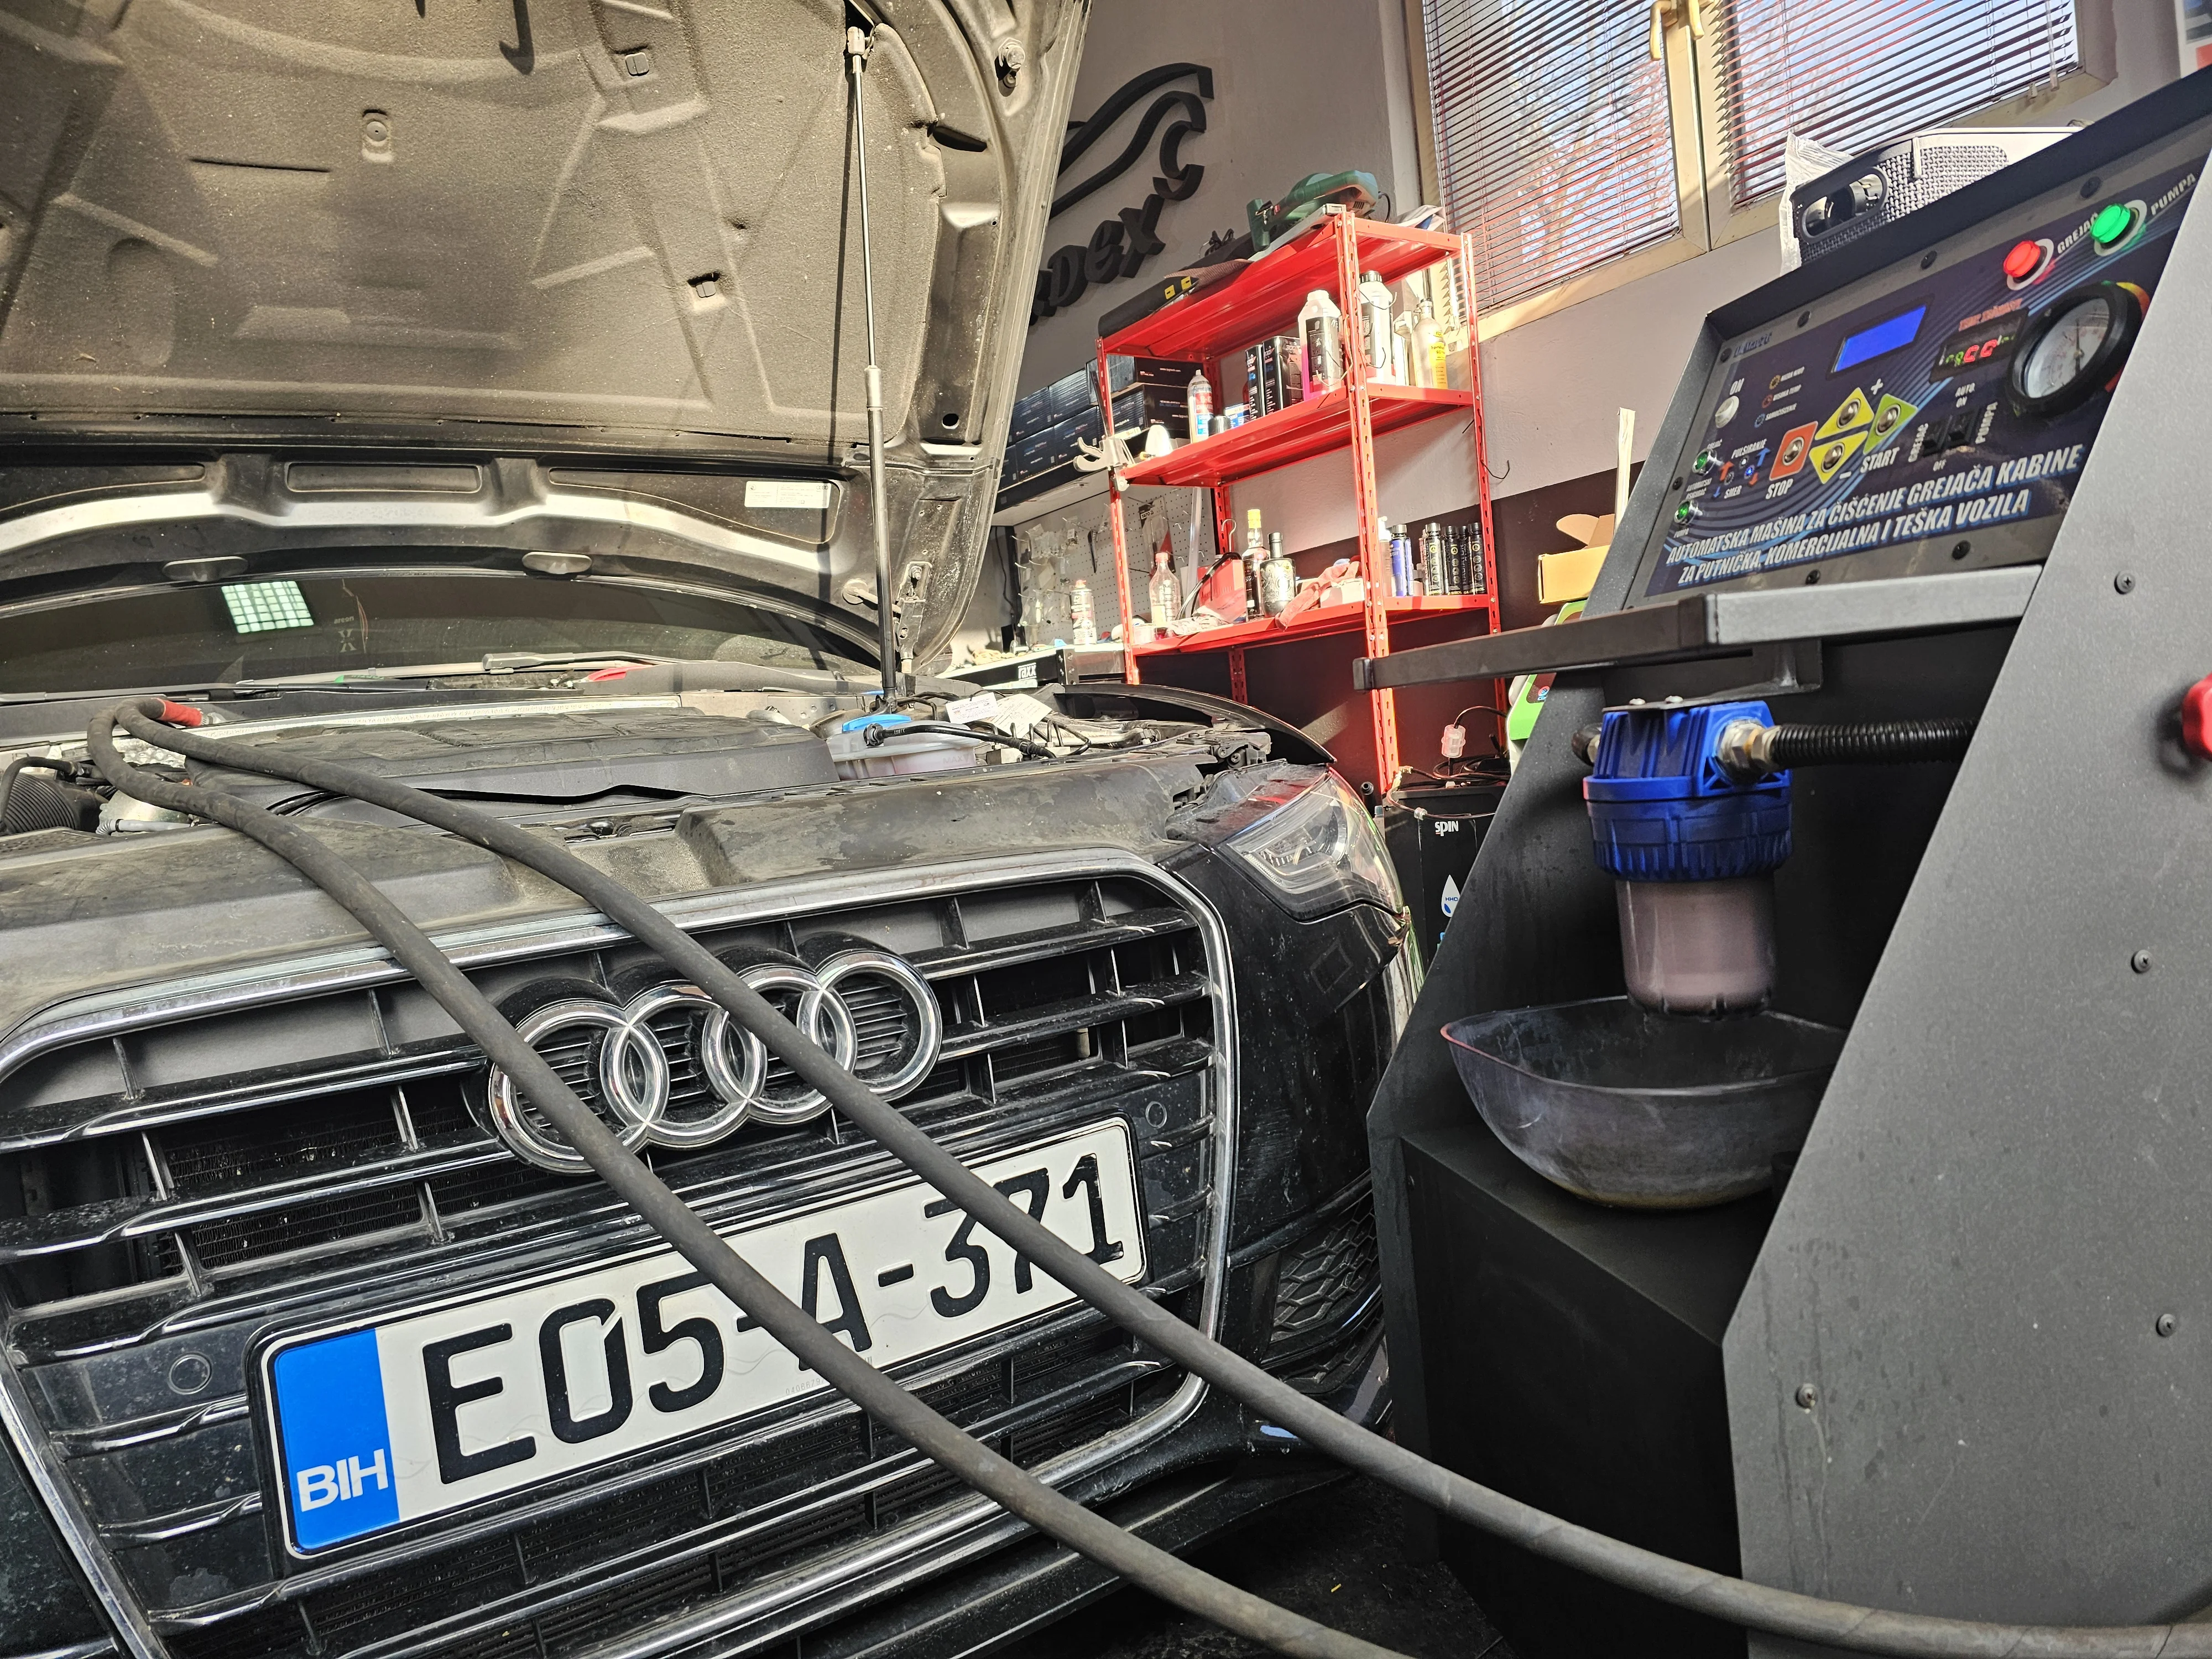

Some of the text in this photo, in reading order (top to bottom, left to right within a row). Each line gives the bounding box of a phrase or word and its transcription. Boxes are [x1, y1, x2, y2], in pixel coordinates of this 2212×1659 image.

[2151, 173, 2196, 215] PUMPA
[1729, 378, 1745, 395] ON
[1975, 401, 1998, 444] PUMPA
[1859, 446, 1900, 474] START
[1933, 458, 1947, 472] OFF
[1724, 485, 1743, 499] SMER
[1765, 478, 1794, 499] STOP
[1666, 444, 2084, 565] AUTOMATSKA MAŠINA ZA ČIŠĆENJE GREJAČA KABINE
[1678, 565, 1695, 585] ZA
[1764, 521, 1881, 566] KOMERCIJALNA
[1892, 505, 1953, 538] TEŠKA
[1955, 488, 2030, 526] VOZILA
[942, 755, 963, 764] MAX
[296, 1448, 389, 1512] BIH
